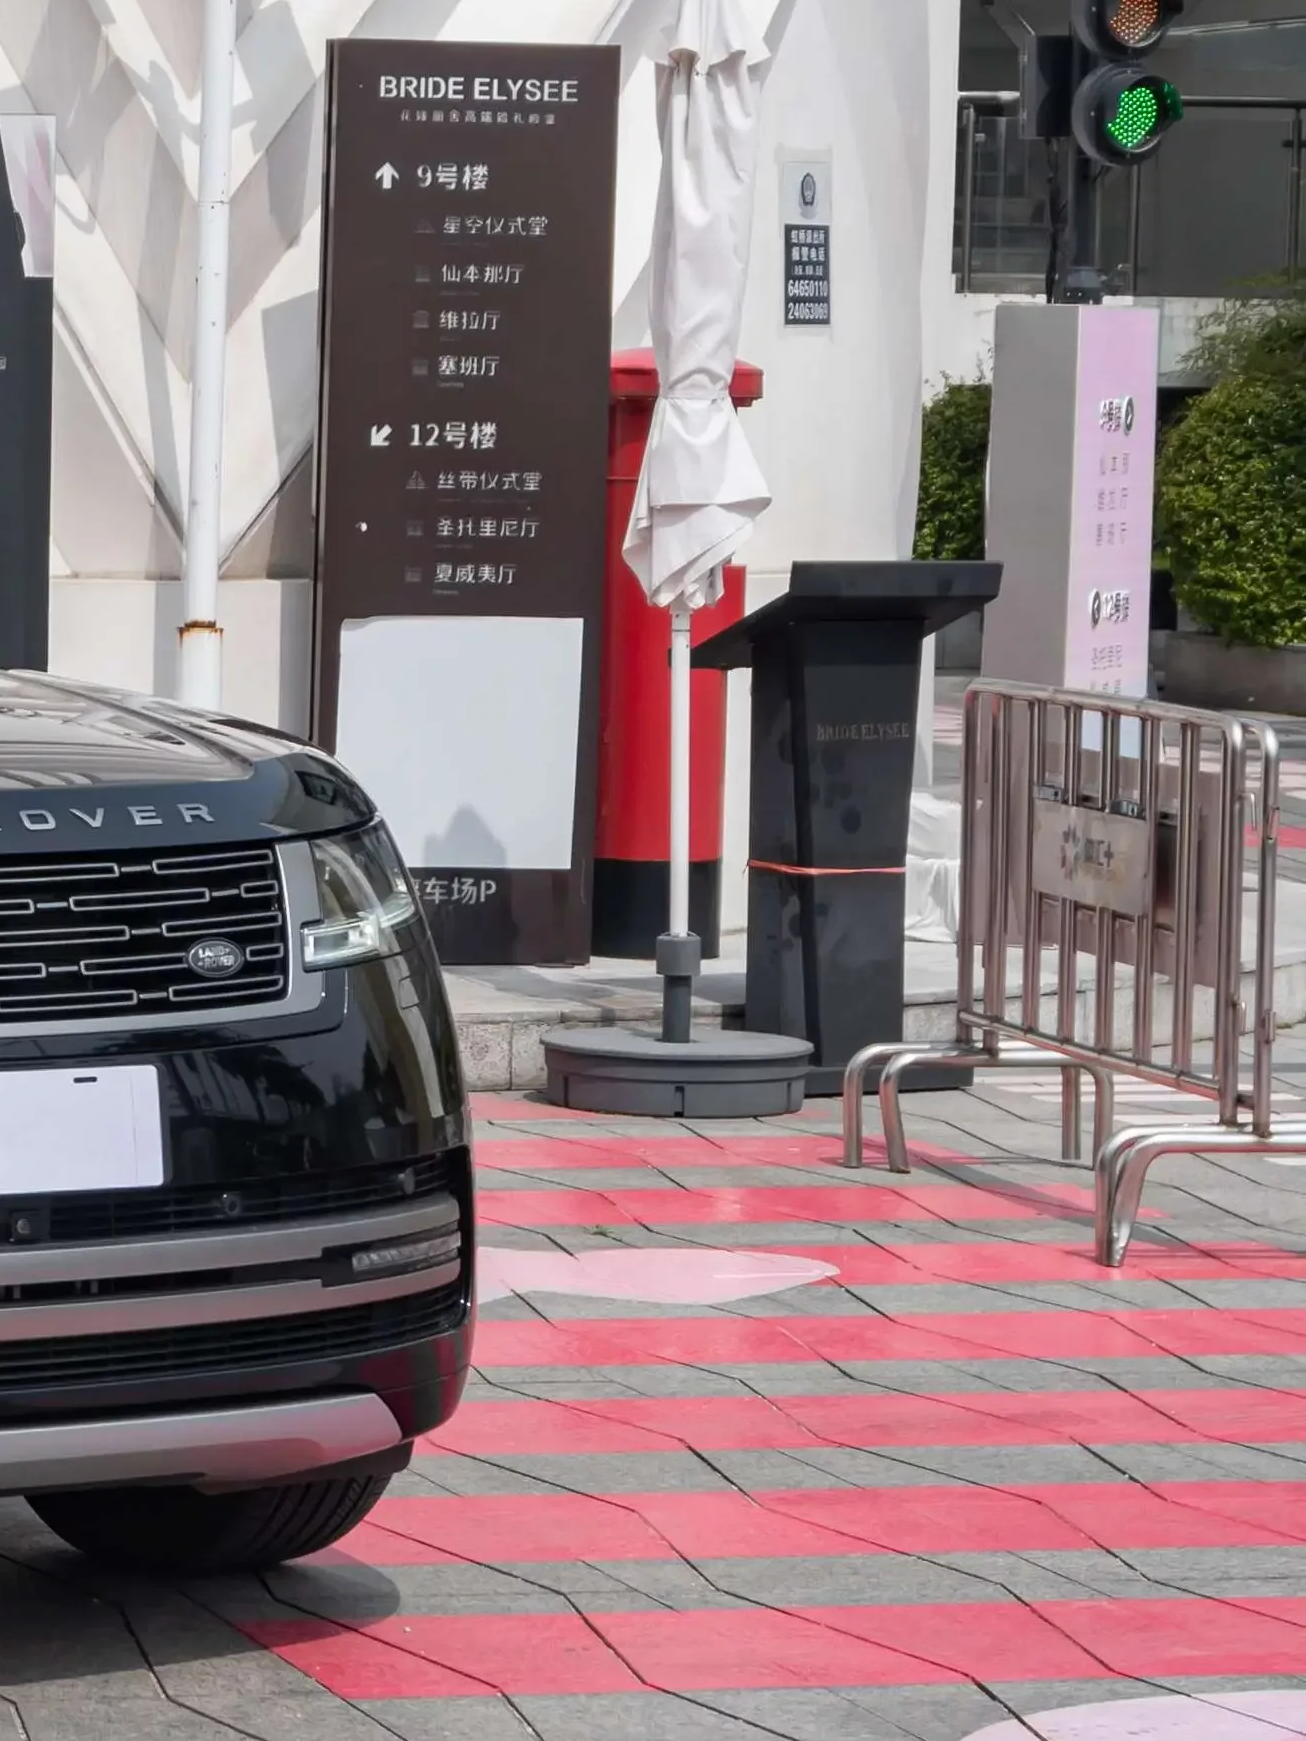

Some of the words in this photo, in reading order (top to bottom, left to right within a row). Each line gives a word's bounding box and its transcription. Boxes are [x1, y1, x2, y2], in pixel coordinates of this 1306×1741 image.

[380, 76, 464, 99] BRIDE
[473, 78, 578, 102] ELYSEE
[417, 163, 489, 191] 9号楼
[443, 215, 548, 236] 星空仪式堂
[441, 263, 524, 284] 仙本那厅
[439, 310, 501, 330] 维拉厅
[438, 355, 500, 376] 塞班厅
[409, 421, 497, 450] 12号楼
[437, 470, 542, 491] 丝带仪式堂
[437, 518, 540, 538] 圣托里尼厅
[434, 562, 518, 584] 夏威夷厅
